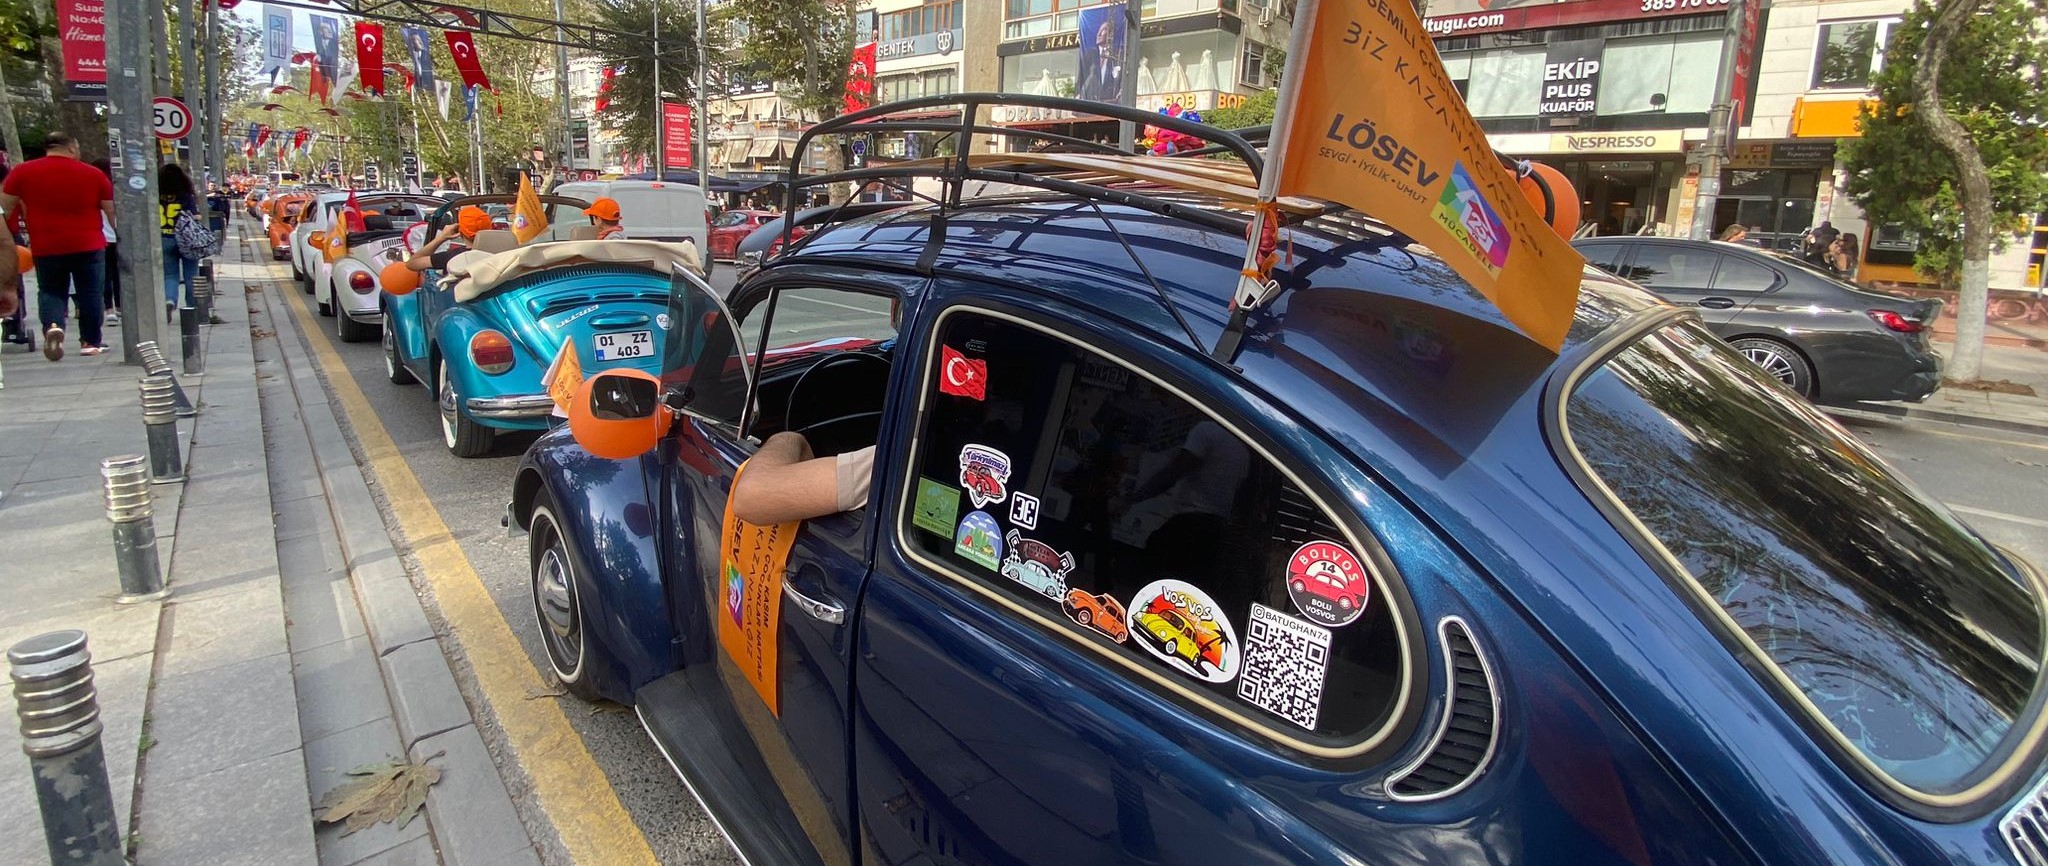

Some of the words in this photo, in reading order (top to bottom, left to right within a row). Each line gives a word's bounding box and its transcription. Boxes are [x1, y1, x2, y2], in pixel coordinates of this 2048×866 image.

[877, 40, 914, 57] GENTEK
[1544, 58, 1599, 81] EKİP
[1546, 83, 1592, 98] PLUS
[1540, 100, 1595, 113] KUAFÖR
[153, 108, 183, 129] 50
[1326, 113, 1440, 187] LÖSEV
[1565, 135, 1656, 150] NESPRESSO
[1396, 181, 1428, 204] UMUT
[600, 335, 615, 347] 01
[631, 332, 648, 344] ZZ
[617, 345, 640, 357] 403
[1299, 548, 1359, 582] BOLVOS
[1321, 562, 1336, 574] 14
[1305, 604, 1336, 621] VOSVOS
[1311, 598, 1332, 611] BOLU
[1265, 611, 1328, 642] BATUGHAN74
